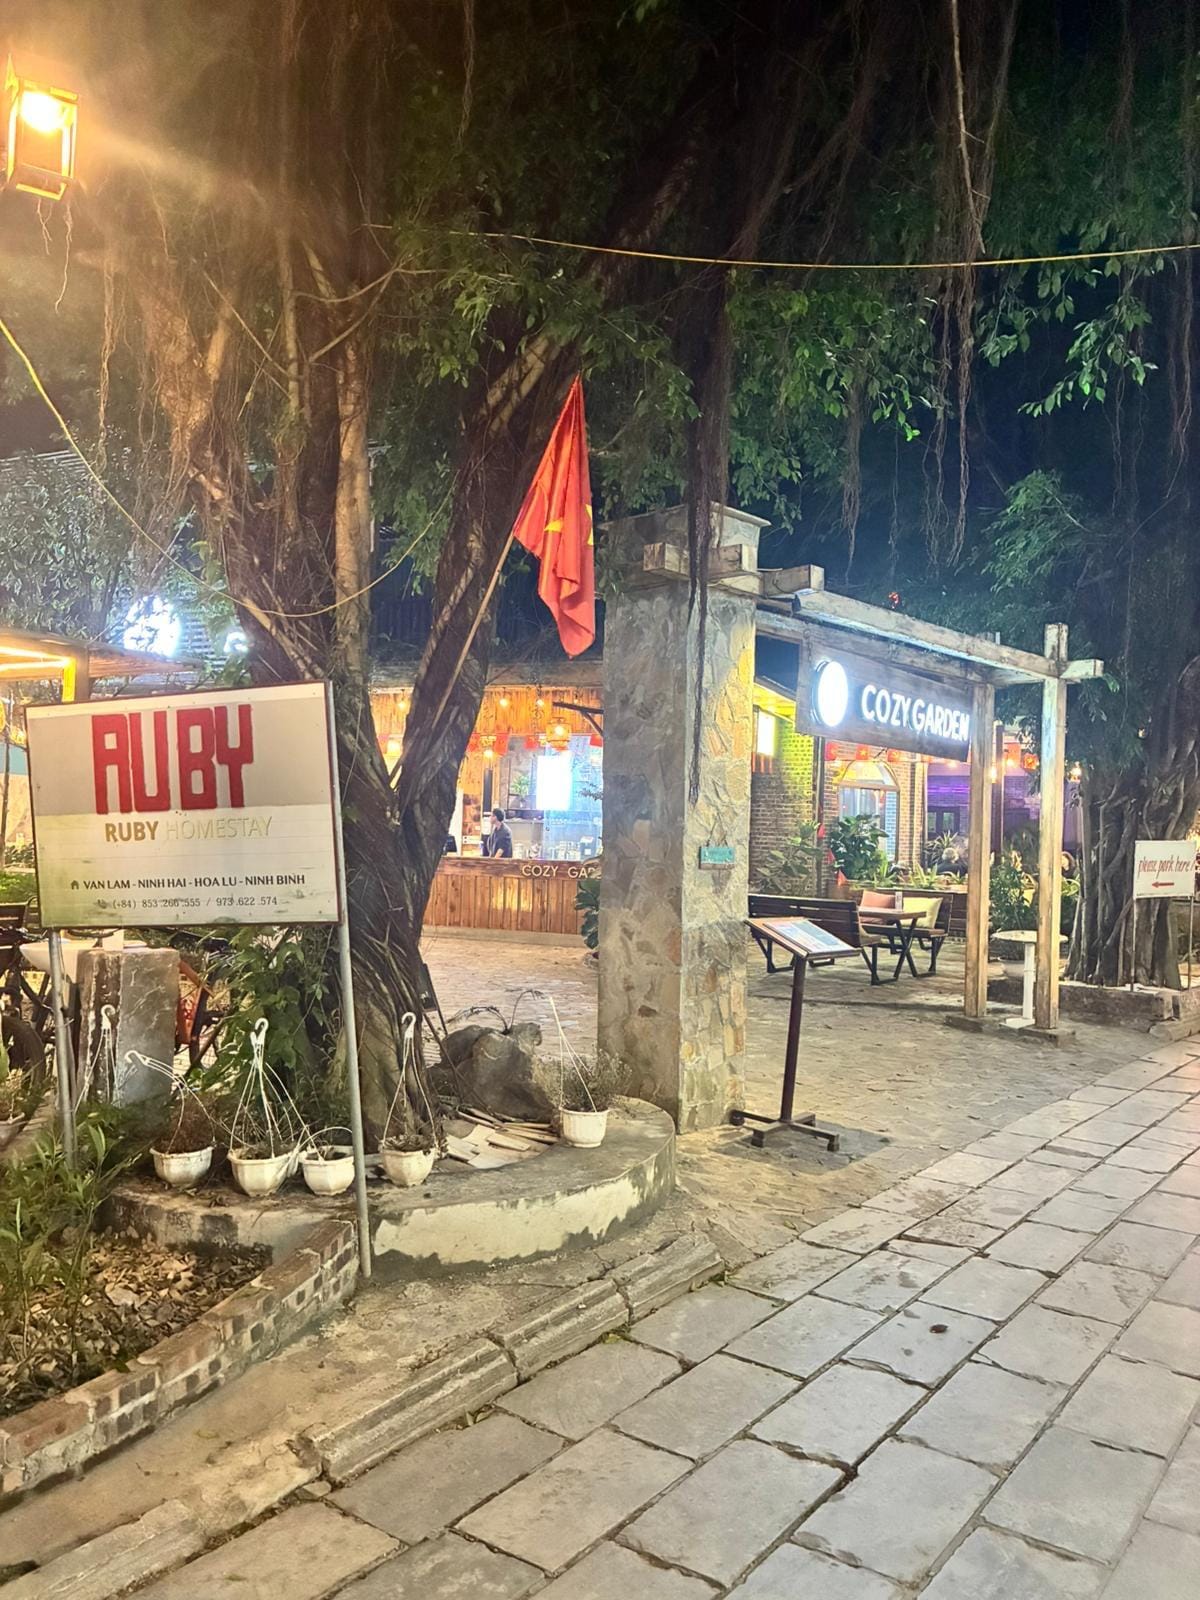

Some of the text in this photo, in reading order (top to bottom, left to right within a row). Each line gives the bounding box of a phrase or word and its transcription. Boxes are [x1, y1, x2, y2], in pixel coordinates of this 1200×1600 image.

[861, 684, 970, 741] COZY GARDEN
[92, 704, 254, 814] RUBY
[105, 816, 273, 842] RUBY HOMESTAY
[522, 864, 559, 877] COZY
[83, 880, 105, 890] VAN
[107, 879, 131, 889] LAM
[138, 878, 165, 889] NINH
[167, 878, 187, 888] HAI
[194, 876, 220, 887] HOA
[222, 876, 237, 886] LU
[245, 875, 274, 886] NINH
[276, 874, 305, 885] BINH
[112, 899, 137, 910] (+84)
